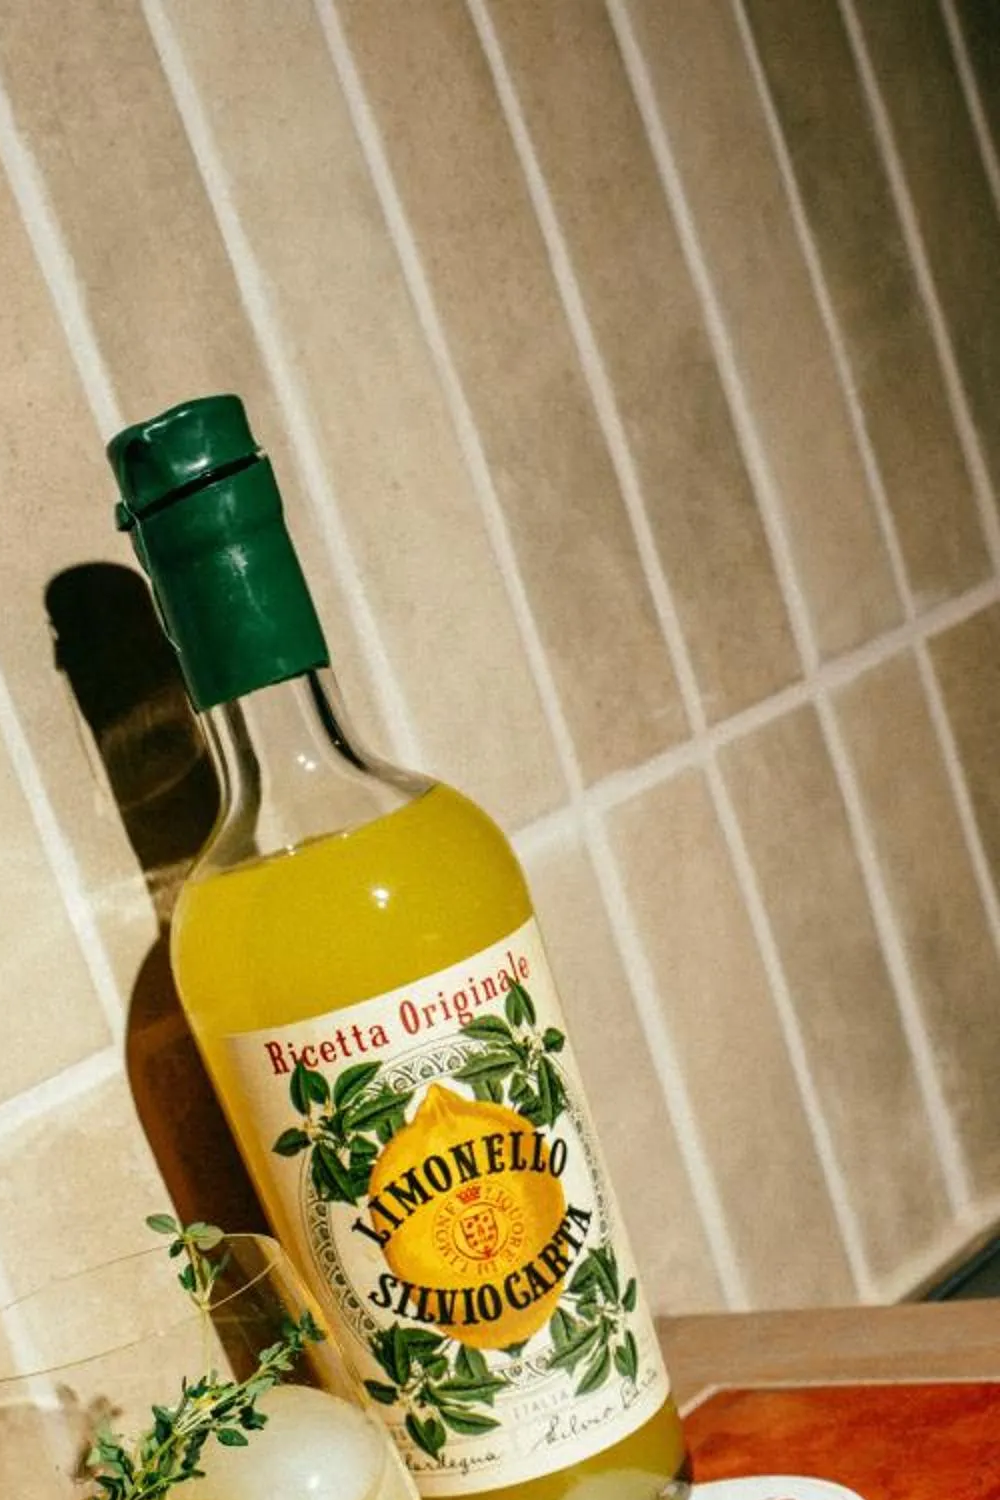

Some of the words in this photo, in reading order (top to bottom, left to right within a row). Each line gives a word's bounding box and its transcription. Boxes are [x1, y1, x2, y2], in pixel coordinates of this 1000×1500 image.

[264, 1024, 389, 1075] Ricetta
[400, 951, 531, 1026] Originale
[352, 1131, 567, 1248] LIMONELLO
[368, 1273, 503, 1326] SILVIO
[504, 1203, 593, 1310] CARTA
